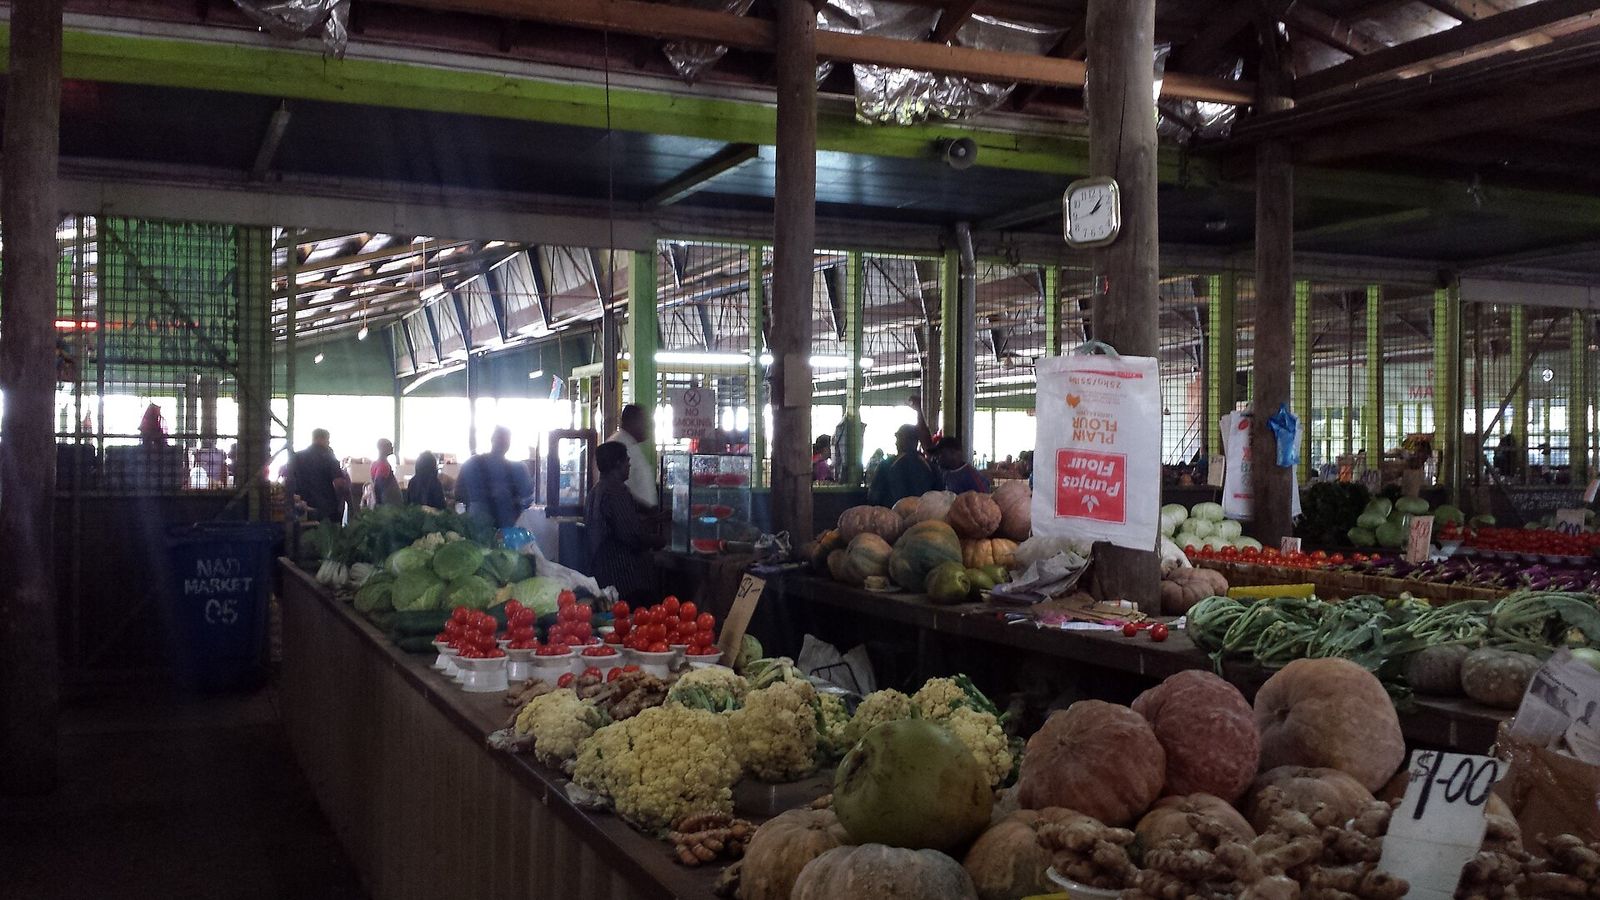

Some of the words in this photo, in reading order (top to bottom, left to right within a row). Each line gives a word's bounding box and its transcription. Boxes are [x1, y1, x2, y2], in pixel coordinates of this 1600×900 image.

[1088, 189, 1096, 199] 12
[685, 407, 699, 417] NO
[1071, 416, 1118, 432] FLOUR
[1072, 428, 1115, 445] PLAIN
[1067, 457, 1115, 477] Flour
[1061, 475, 1121, 497] Punjas
[184, 577, 253, 595] MARKET
